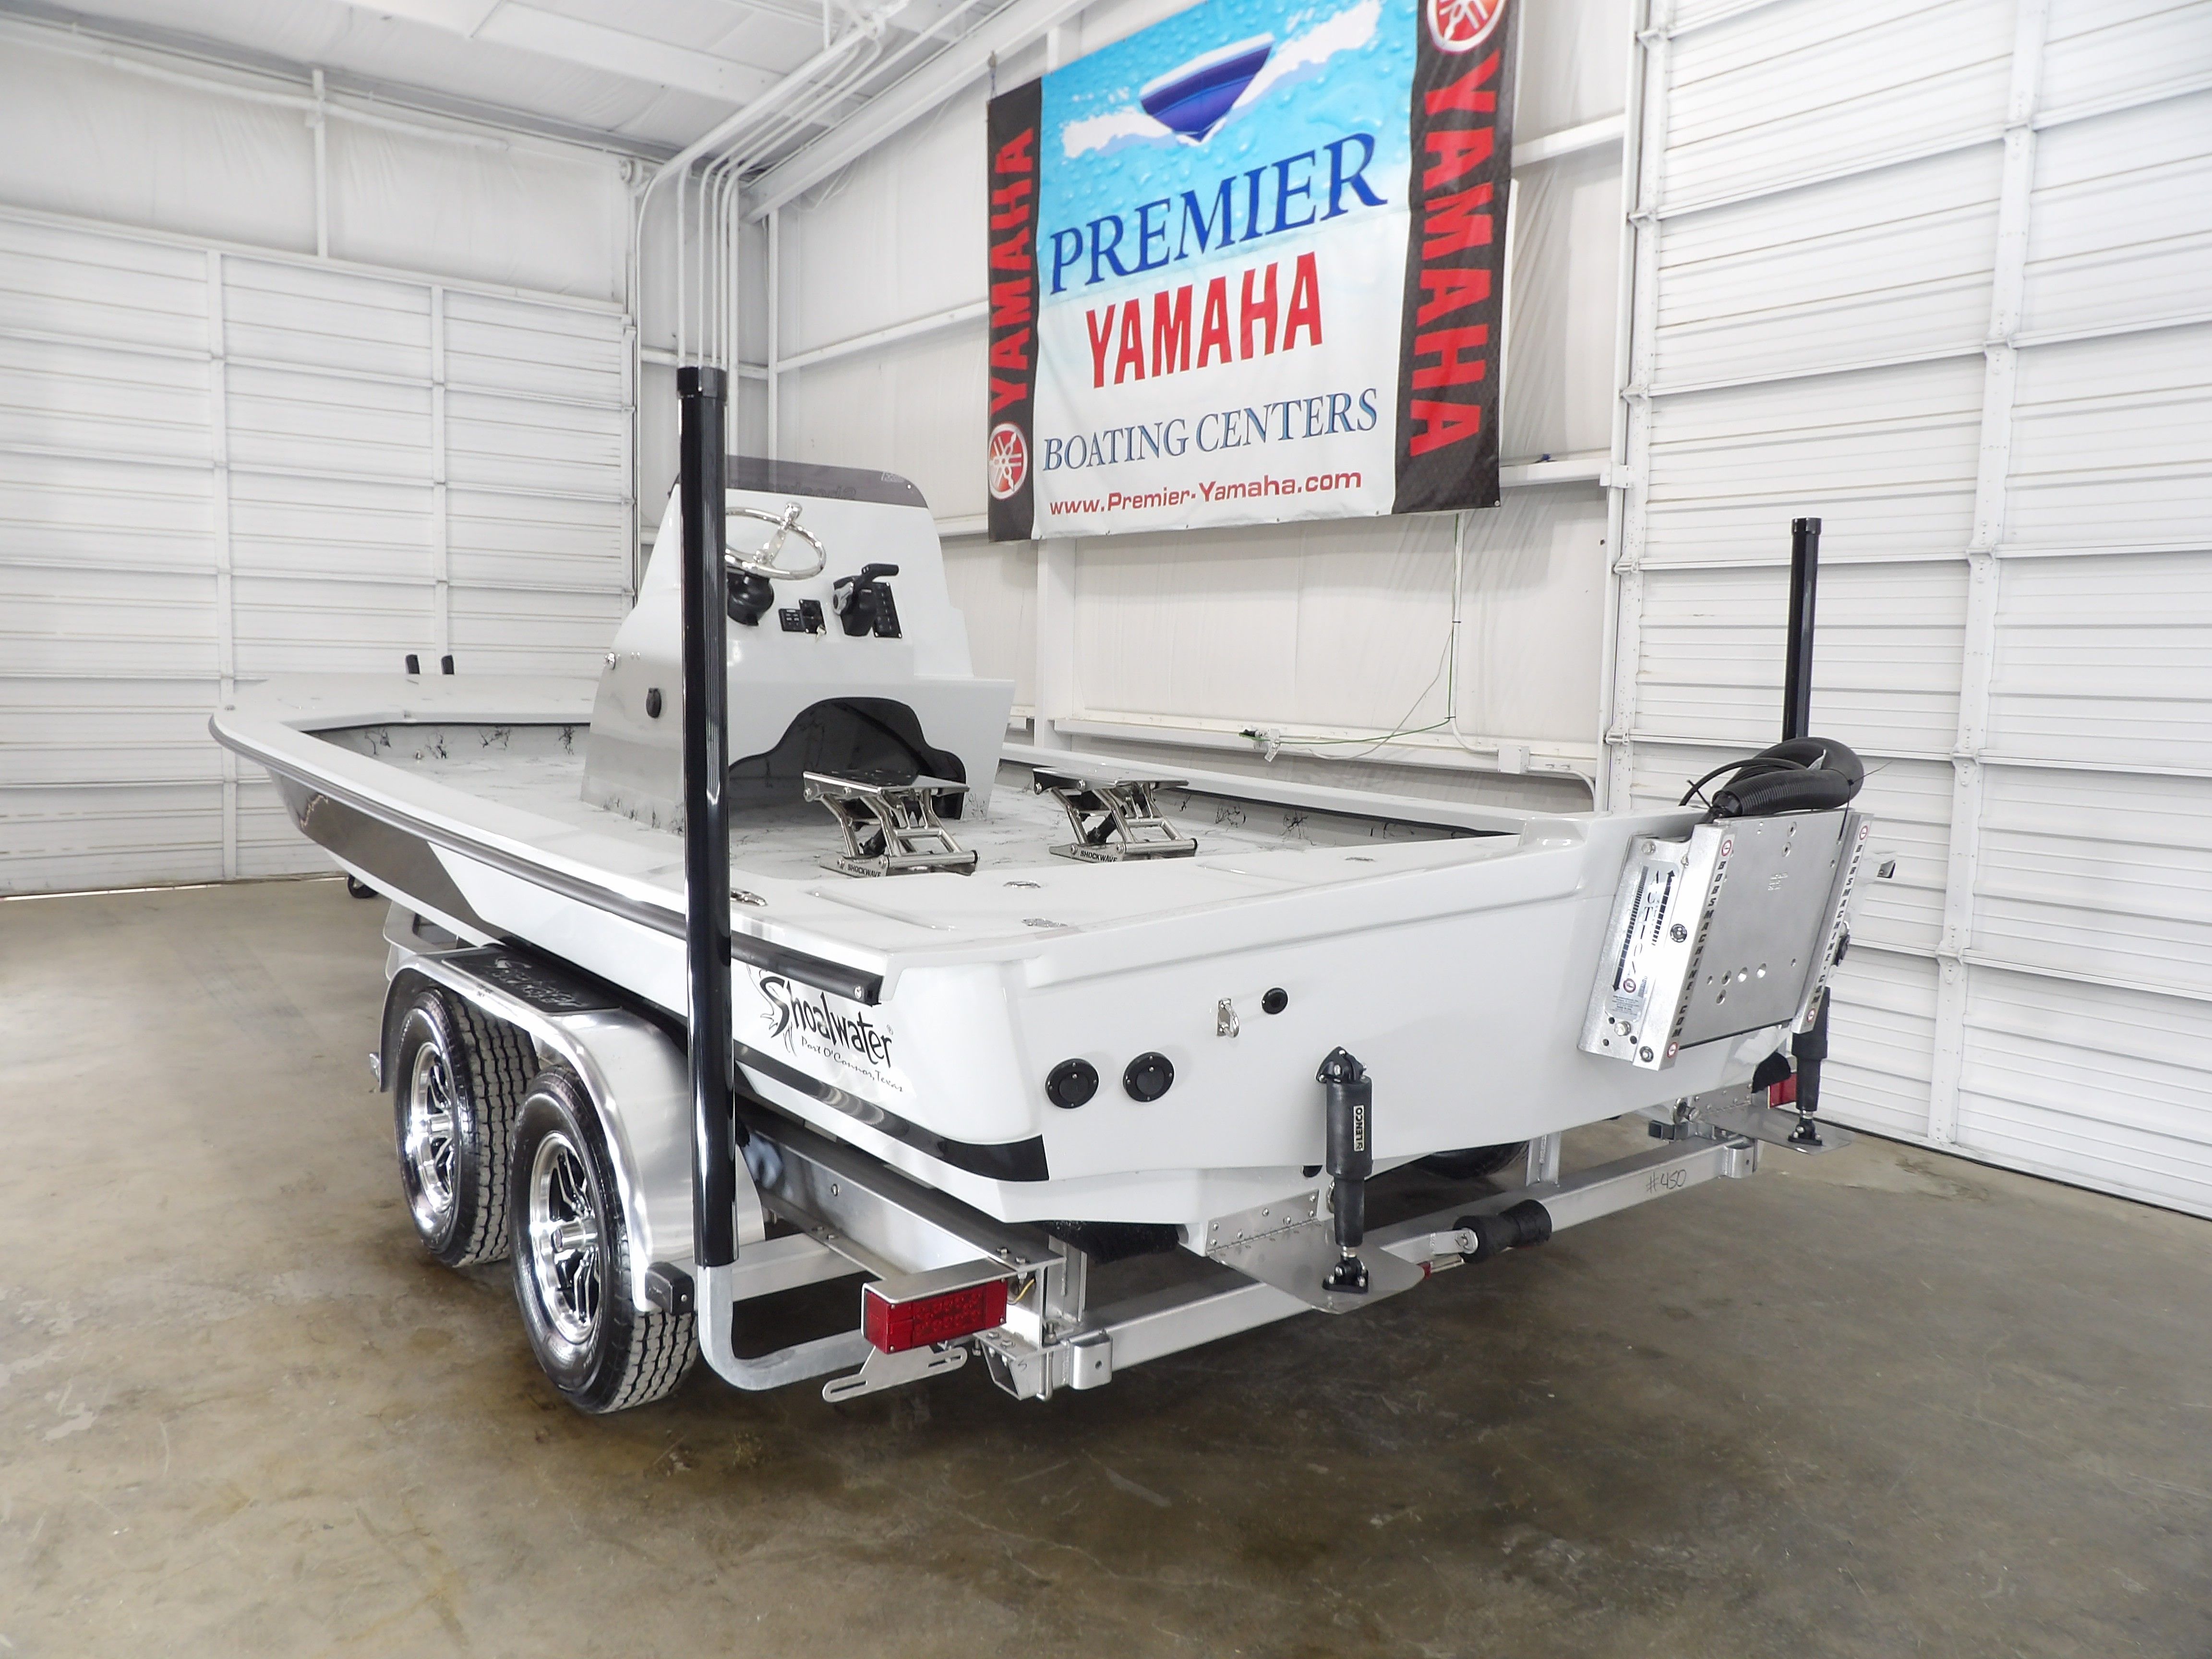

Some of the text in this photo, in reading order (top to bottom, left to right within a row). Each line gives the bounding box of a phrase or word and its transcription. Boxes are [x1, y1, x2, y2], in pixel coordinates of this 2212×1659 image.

[1049, 132, 1387, 295] PREMIER
[1409, 50, 1500, 458] YAMAHA
[989, 127, 1034, 416] YAMAHA
[1085, 252, 1322, 388] YAMAHA
[1042, 388, 1378, 472] BOATING CENTERS
[1049, 469, 1362, 516] www.Premier-Yamaha.com
[847, 864, 881, 878] SHOCKWAVE
[1080, 850, 1118, 862] SHOCKWAVE
[760, 975, 892, 1069] Shoalwater
[1646, 1169, 1686, 1193] #450
